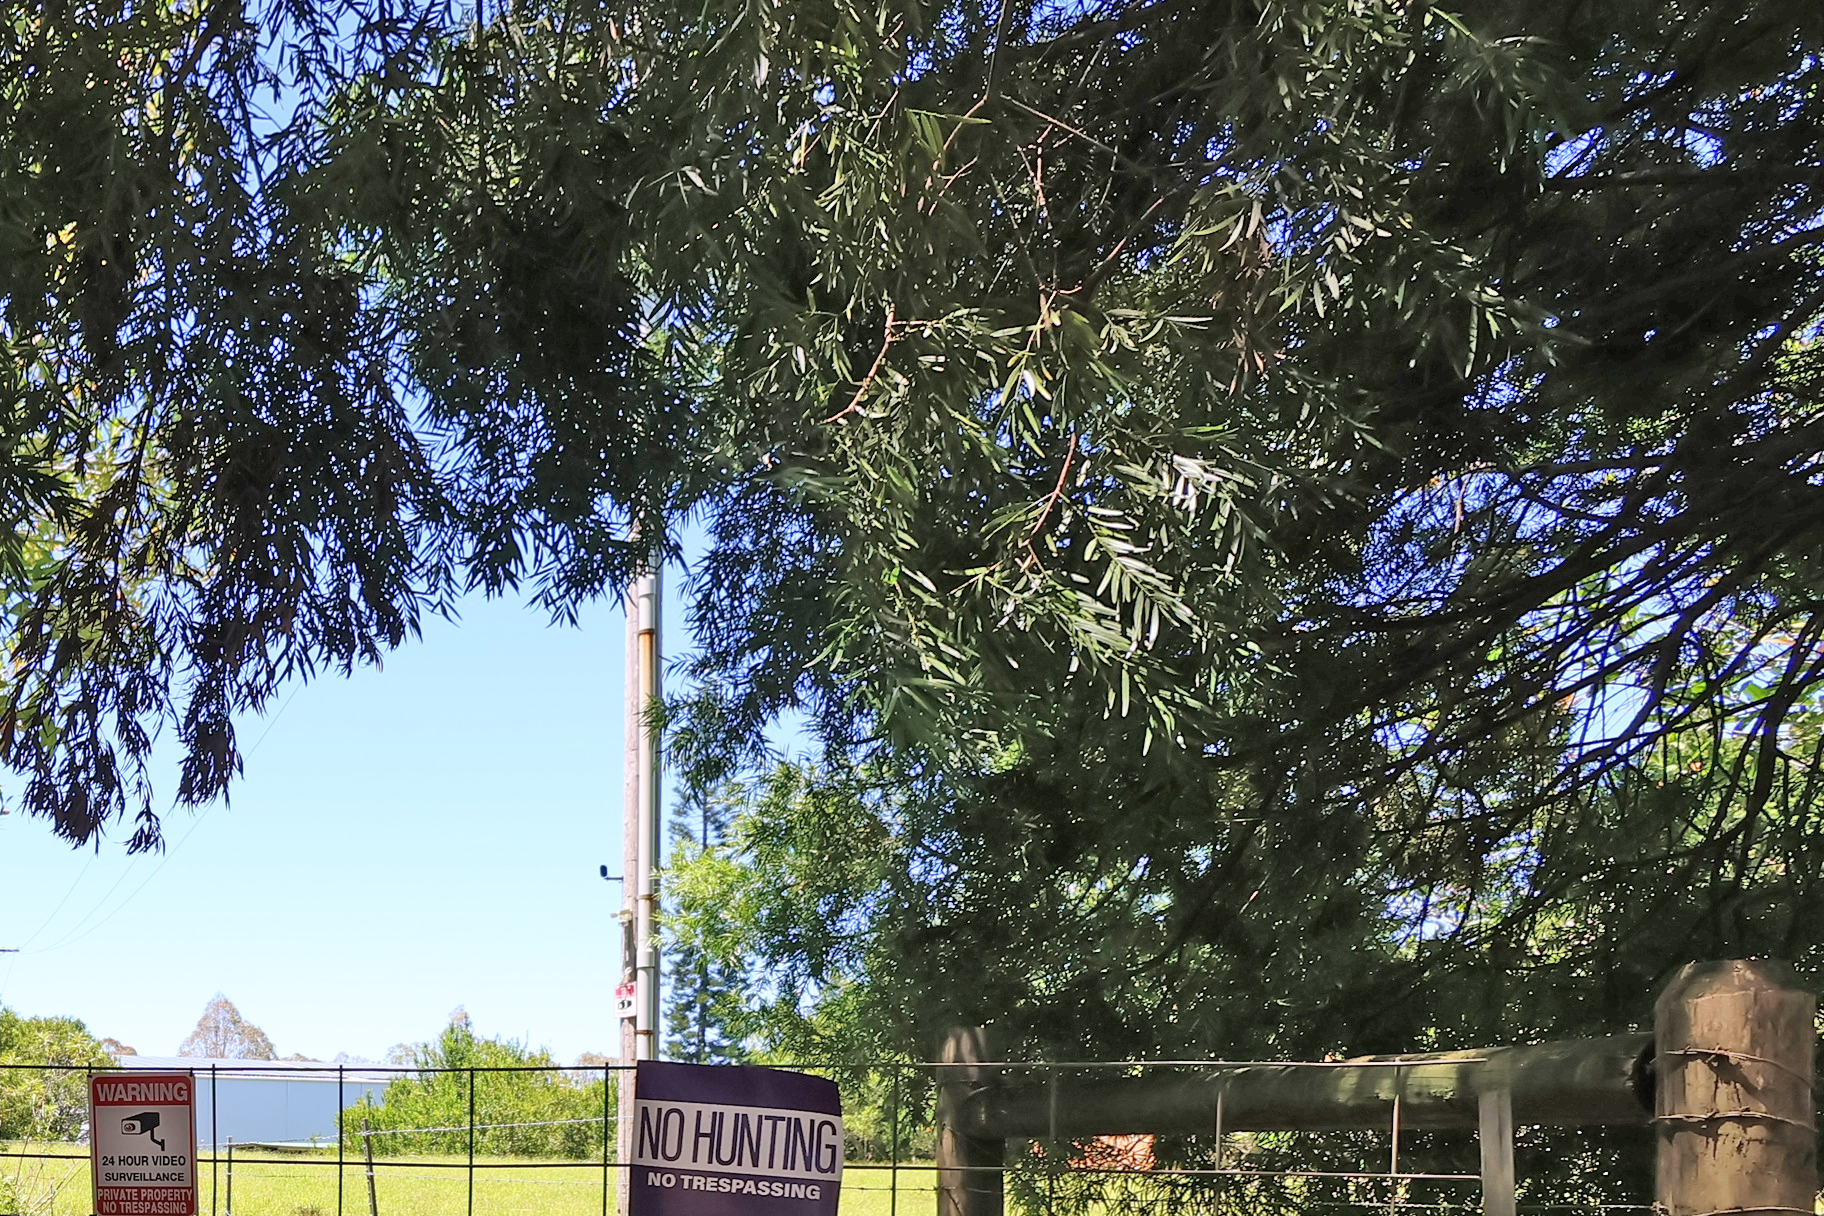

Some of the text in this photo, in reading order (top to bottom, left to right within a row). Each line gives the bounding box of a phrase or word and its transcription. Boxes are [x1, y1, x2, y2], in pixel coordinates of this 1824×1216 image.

[96, 1083, 188, 1102] WARNING
[638, 1106, 838, 1174] NO HUNTING
[102, 1156, 186, 1166] 24 HOUR VIDEO
[105, 1172, 185, 1182] SURVEILLANCE
[647, 1172, 821, 1200] NO TRESPASSING
[98, 1189, 193, 1201] PRIVATE PROPERTY
[103, 1201, 187, 1214] NO TRESPASSING
